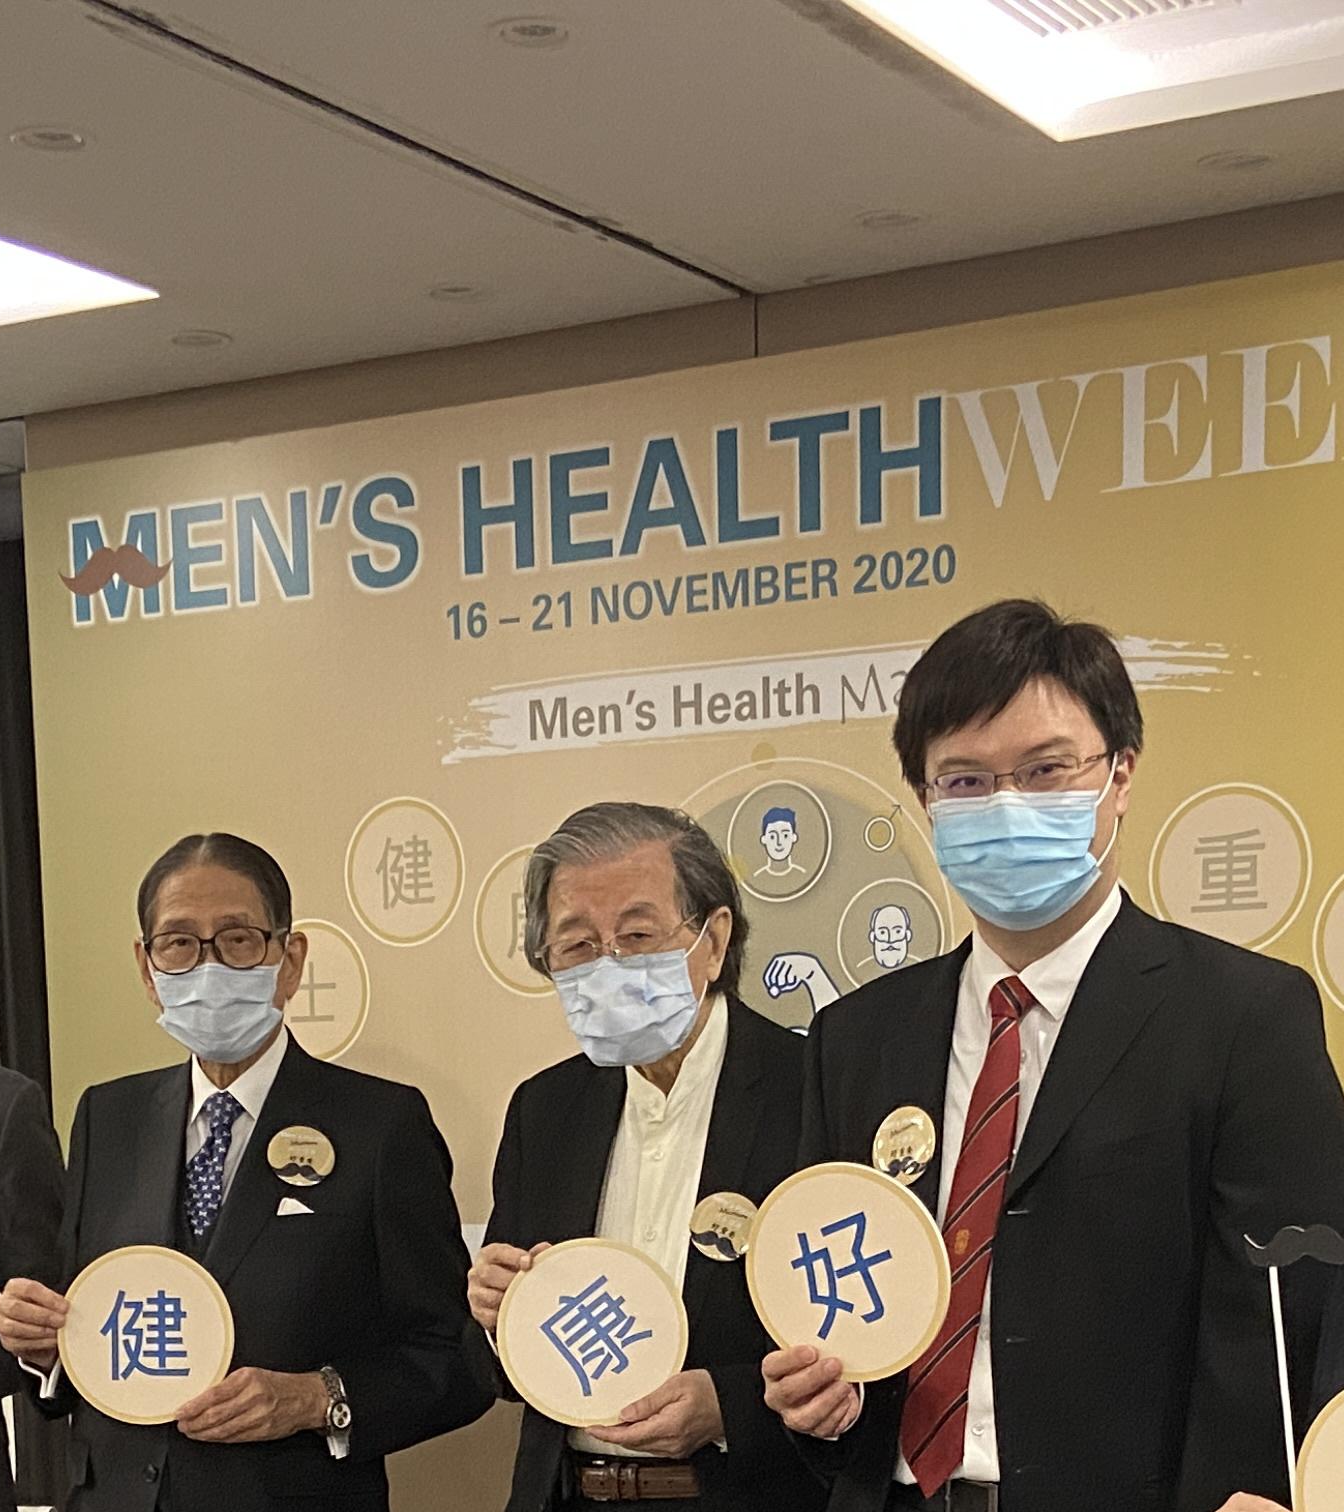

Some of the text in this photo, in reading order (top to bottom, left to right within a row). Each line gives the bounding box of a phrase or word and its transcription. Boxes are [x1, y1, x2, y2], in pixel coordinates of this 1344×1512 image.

[72, 477, 419, 624] MEN'S
[461, 396, 942, 576] HEALTH
[446, 602, 488, 641] 16
[531, 592, 573, 631] 21
[590, 557, 840, 625] NOVEMBER
[853, 543, 957, 594] 2020
[528, 690, 658, 742] Men's
[672, 671, 821, 728] Health
[375, 834, 436, 911] 健
[1191, 828, 1268, 913] 重
[290, 961, 337, 1023] 士
[790, 1210, 893, 1340] 好
[99, 1289, 191, 1381] 健
[538, 1274, 653, 1397] 康
